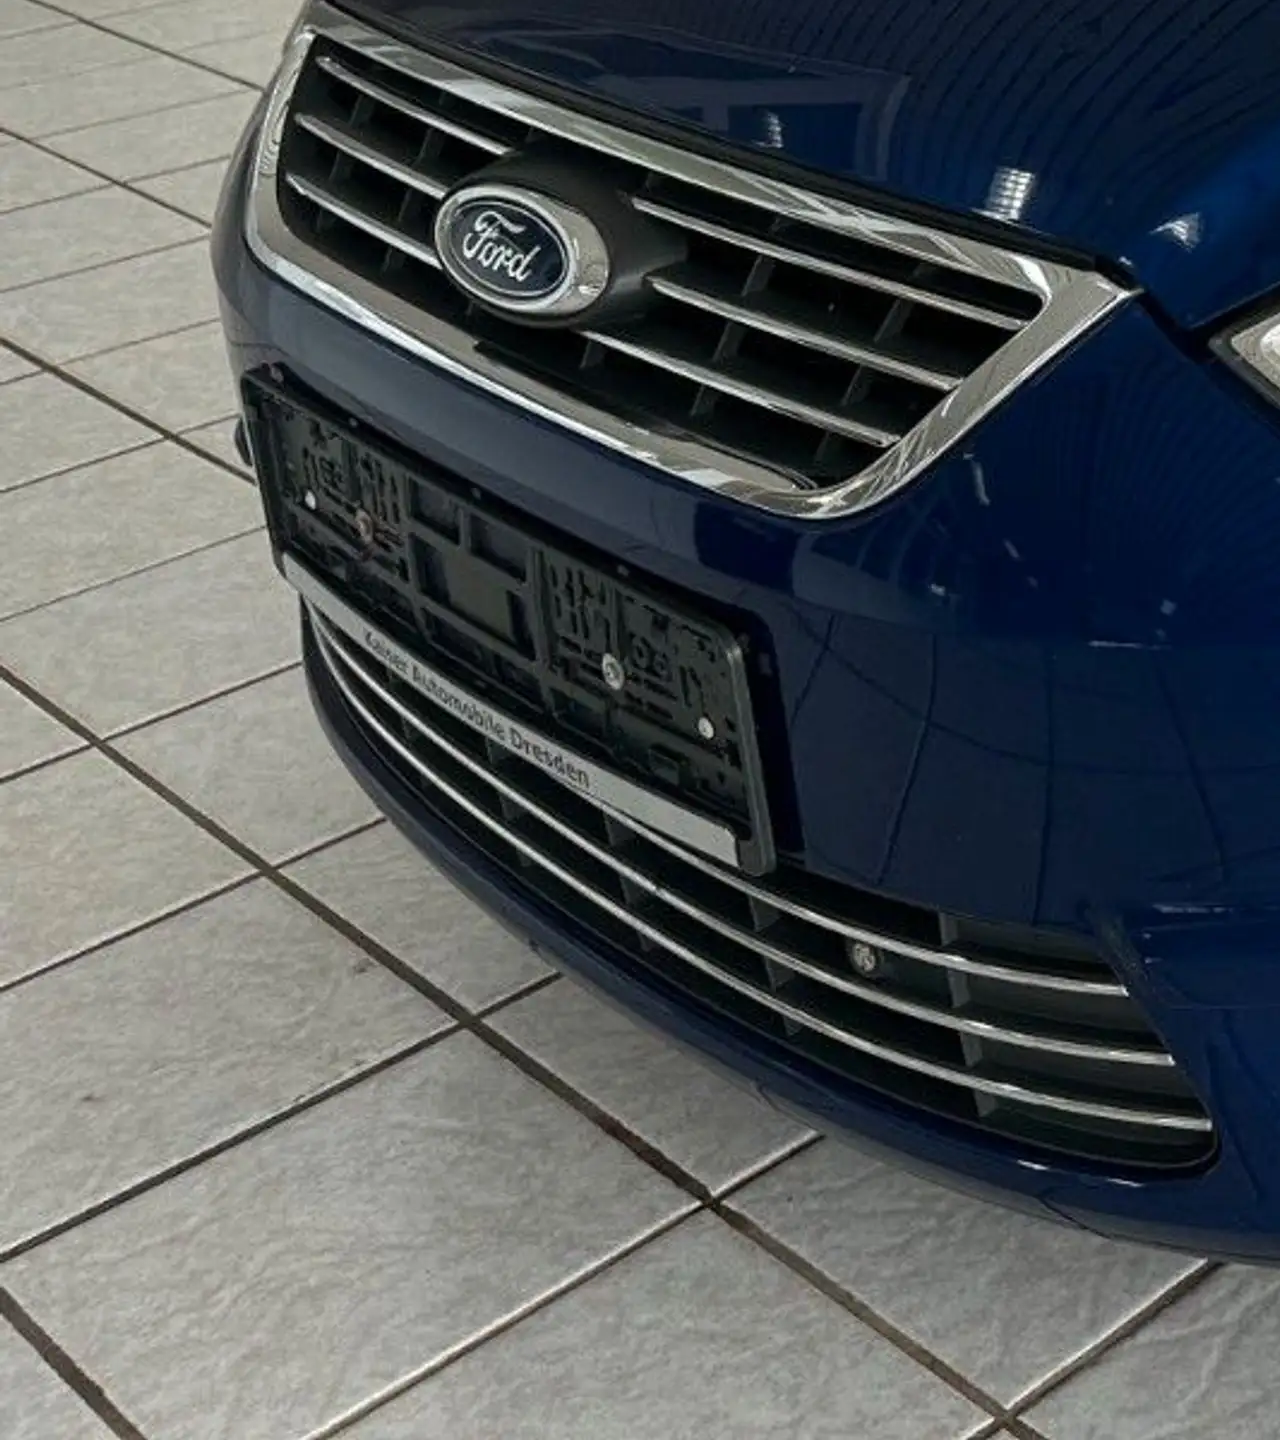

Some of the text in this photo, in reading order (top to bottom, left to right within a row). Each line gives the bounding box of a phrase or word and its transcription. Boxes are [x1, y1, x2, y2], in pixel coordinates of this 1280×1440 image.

[462, 210, 541, 283] Ford
[412, 664, 506, 742] Automobile
[509, 726, 590, 790] Dresden
